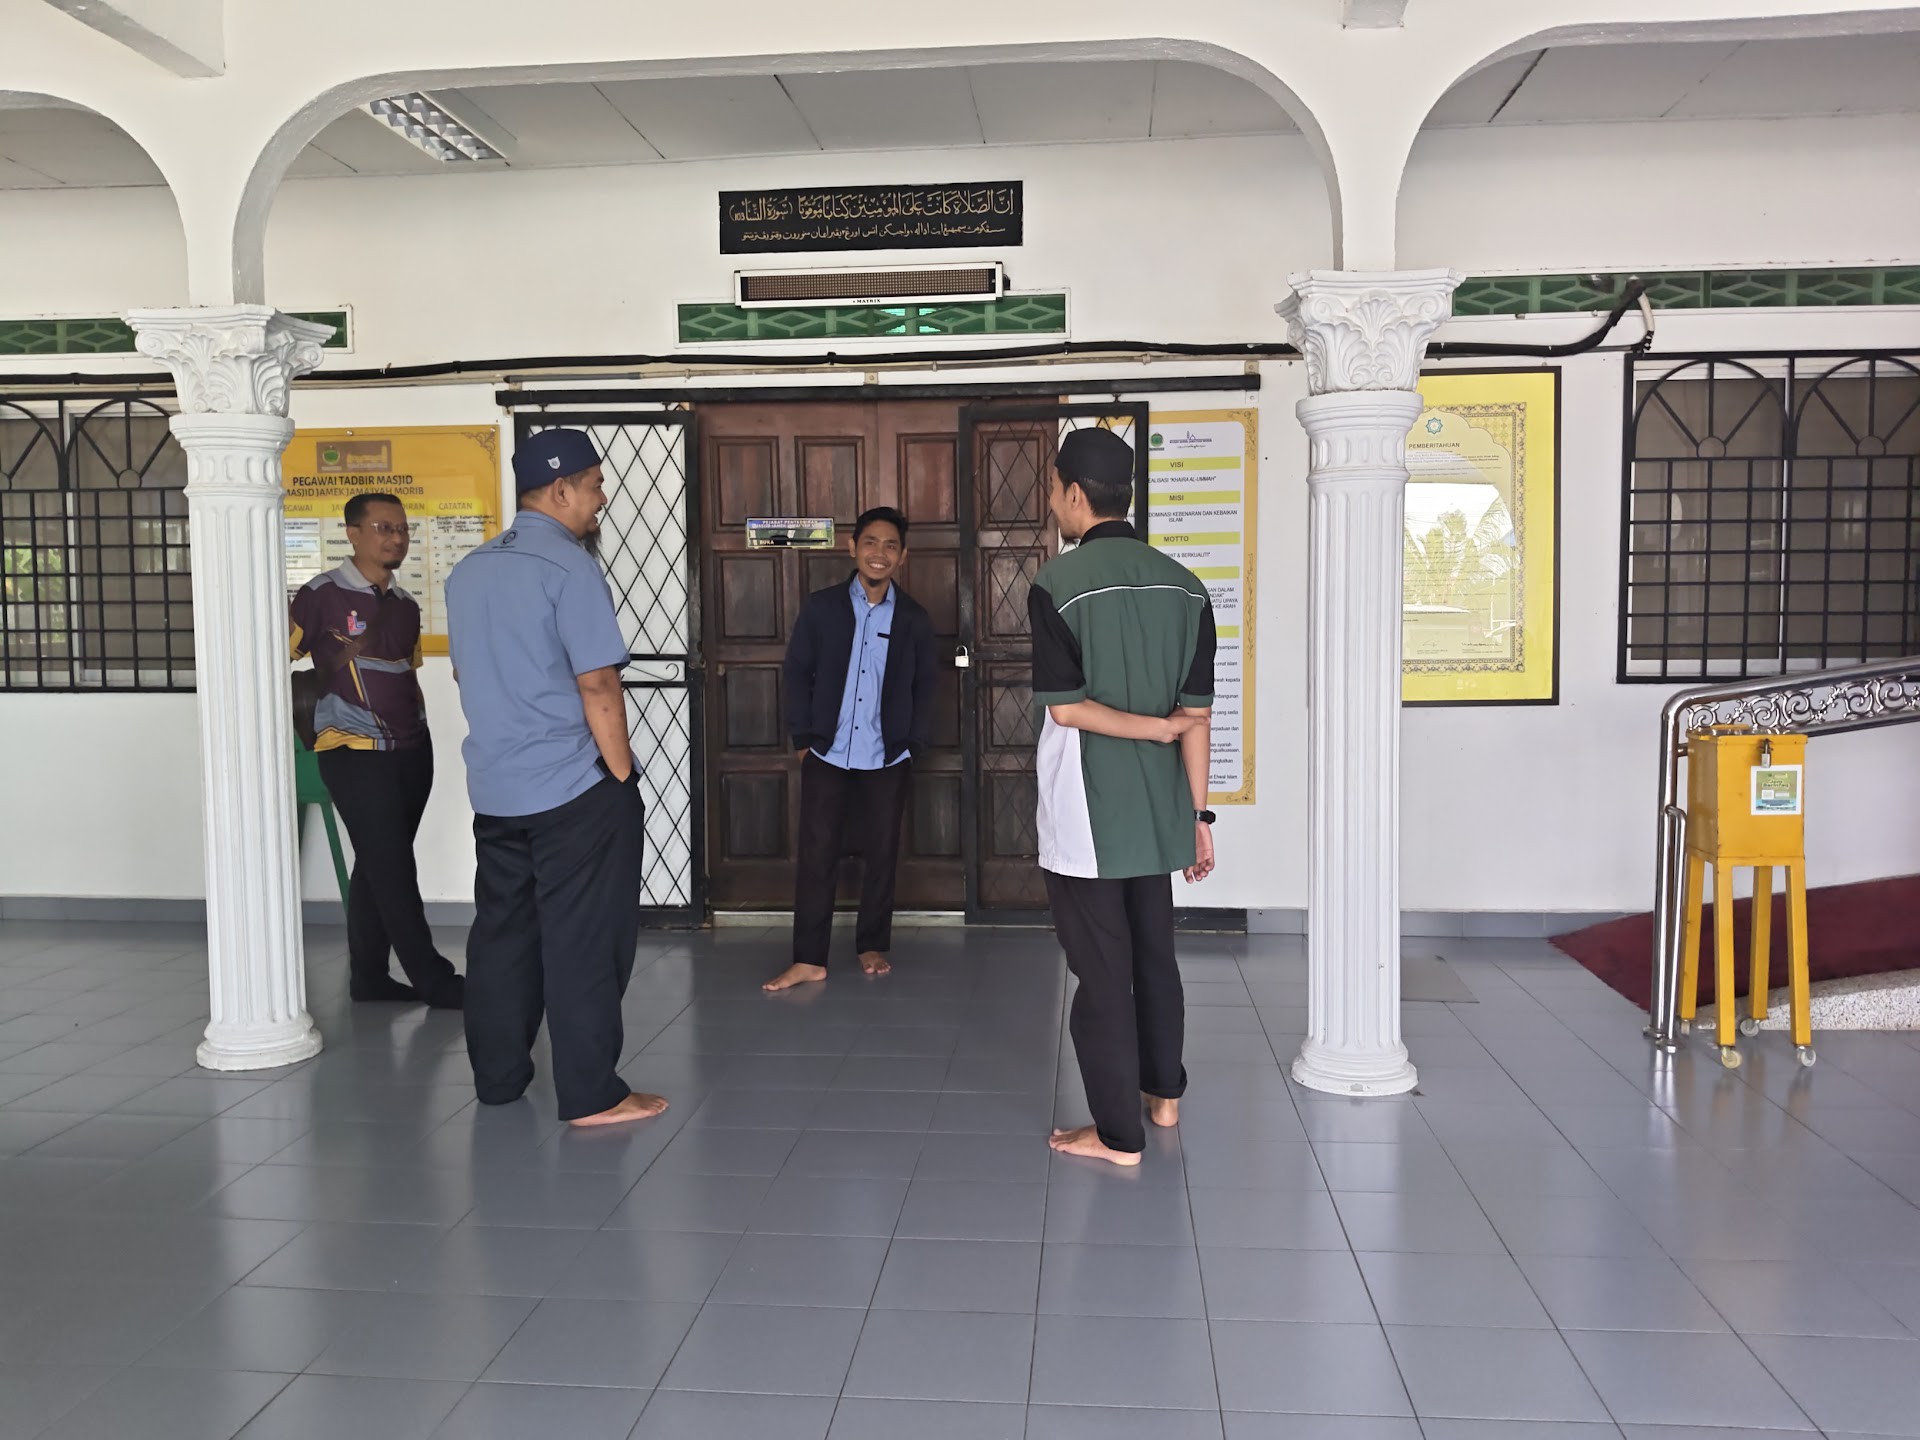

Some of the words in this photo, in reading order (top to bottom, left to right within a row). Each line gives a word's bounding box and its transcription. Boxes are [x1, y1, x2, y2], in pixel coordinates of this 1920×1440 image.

[292, 476, 337, 487] PEGAWAI
[338, 475, 375, 486] TADBIR
[377, 474, 413, 486] MASJID
[316, 487, 345, 497] JAMEK
[394, 486, 424, 495] MORIB
[438, 502, 473, 510] CATATAN
